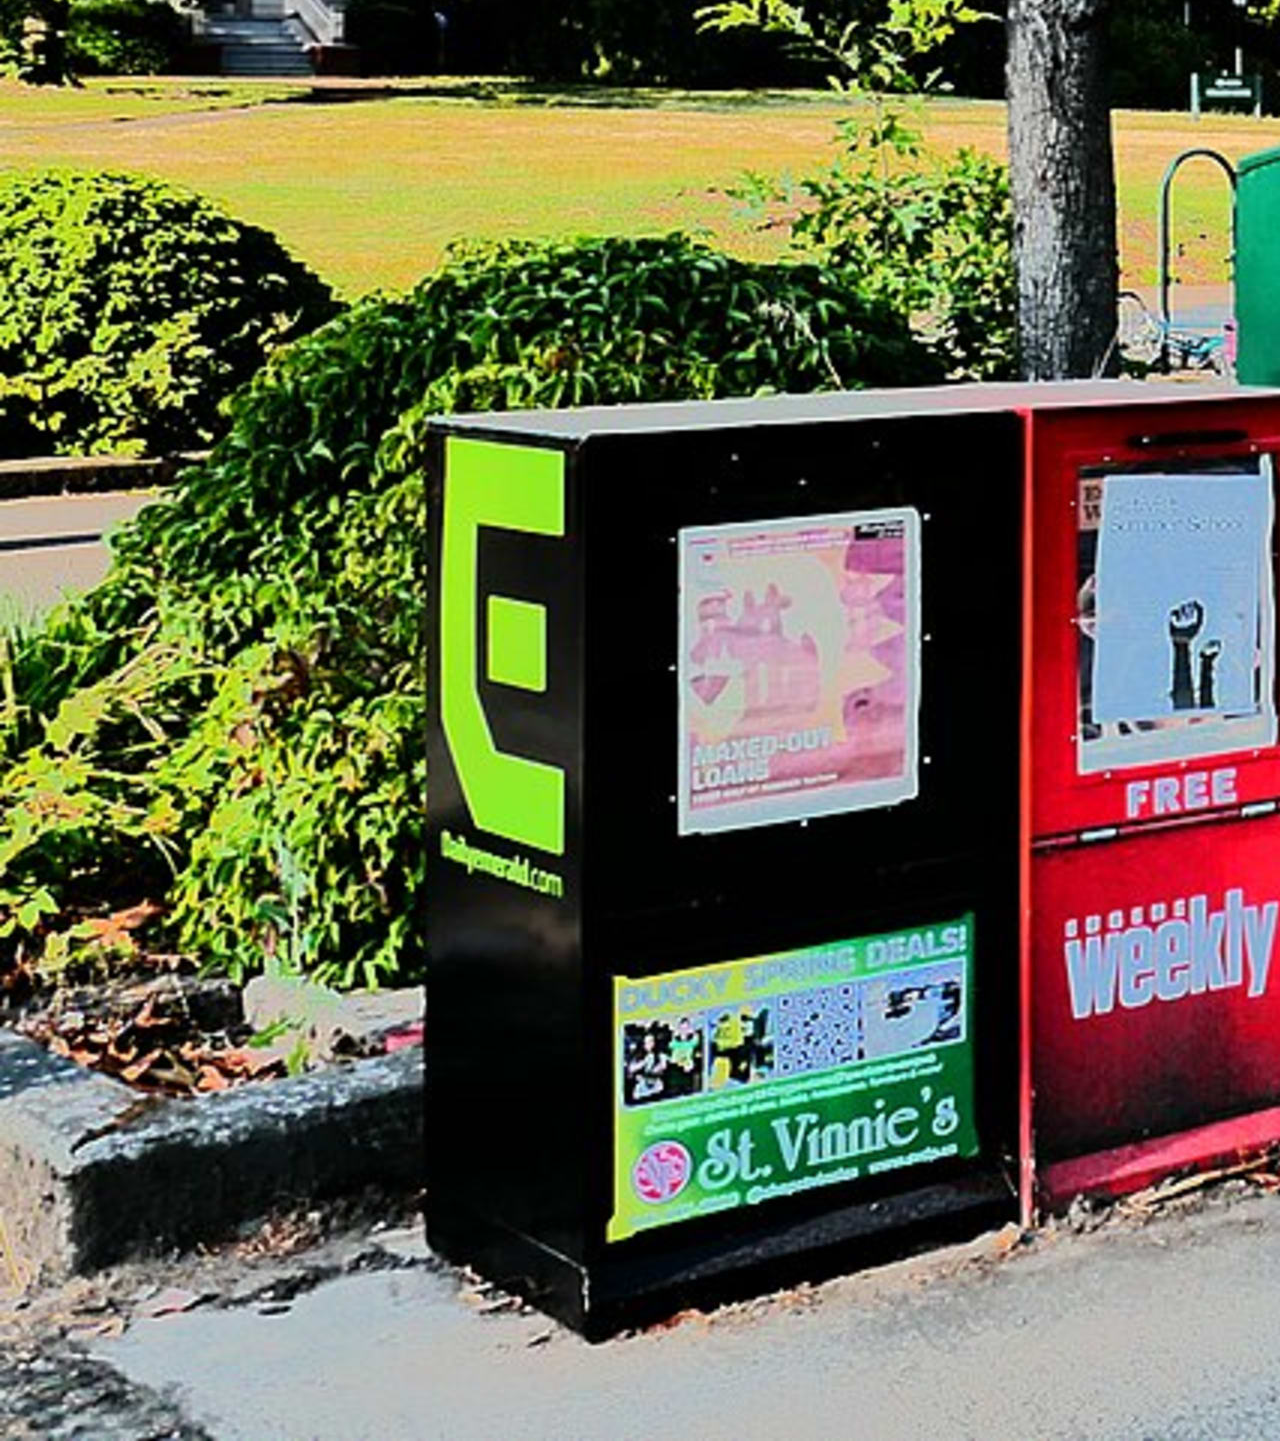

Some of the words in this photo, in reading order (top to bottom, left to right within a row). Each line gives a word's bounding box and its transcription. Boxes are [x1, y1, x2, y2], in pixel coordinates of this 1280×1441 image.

[1126, 768, 1238, 818] FREE
[620, 970, 734, 1010] DUCKY
[746, 946, 857, 989] SPRING
[866, 925, 967, 968] DEALS!
[1065, 888, 1280, 1019] weekly
[698, 1129, 773, 1190] St.
[770, 1086, 959, 1171] Vinnie's
